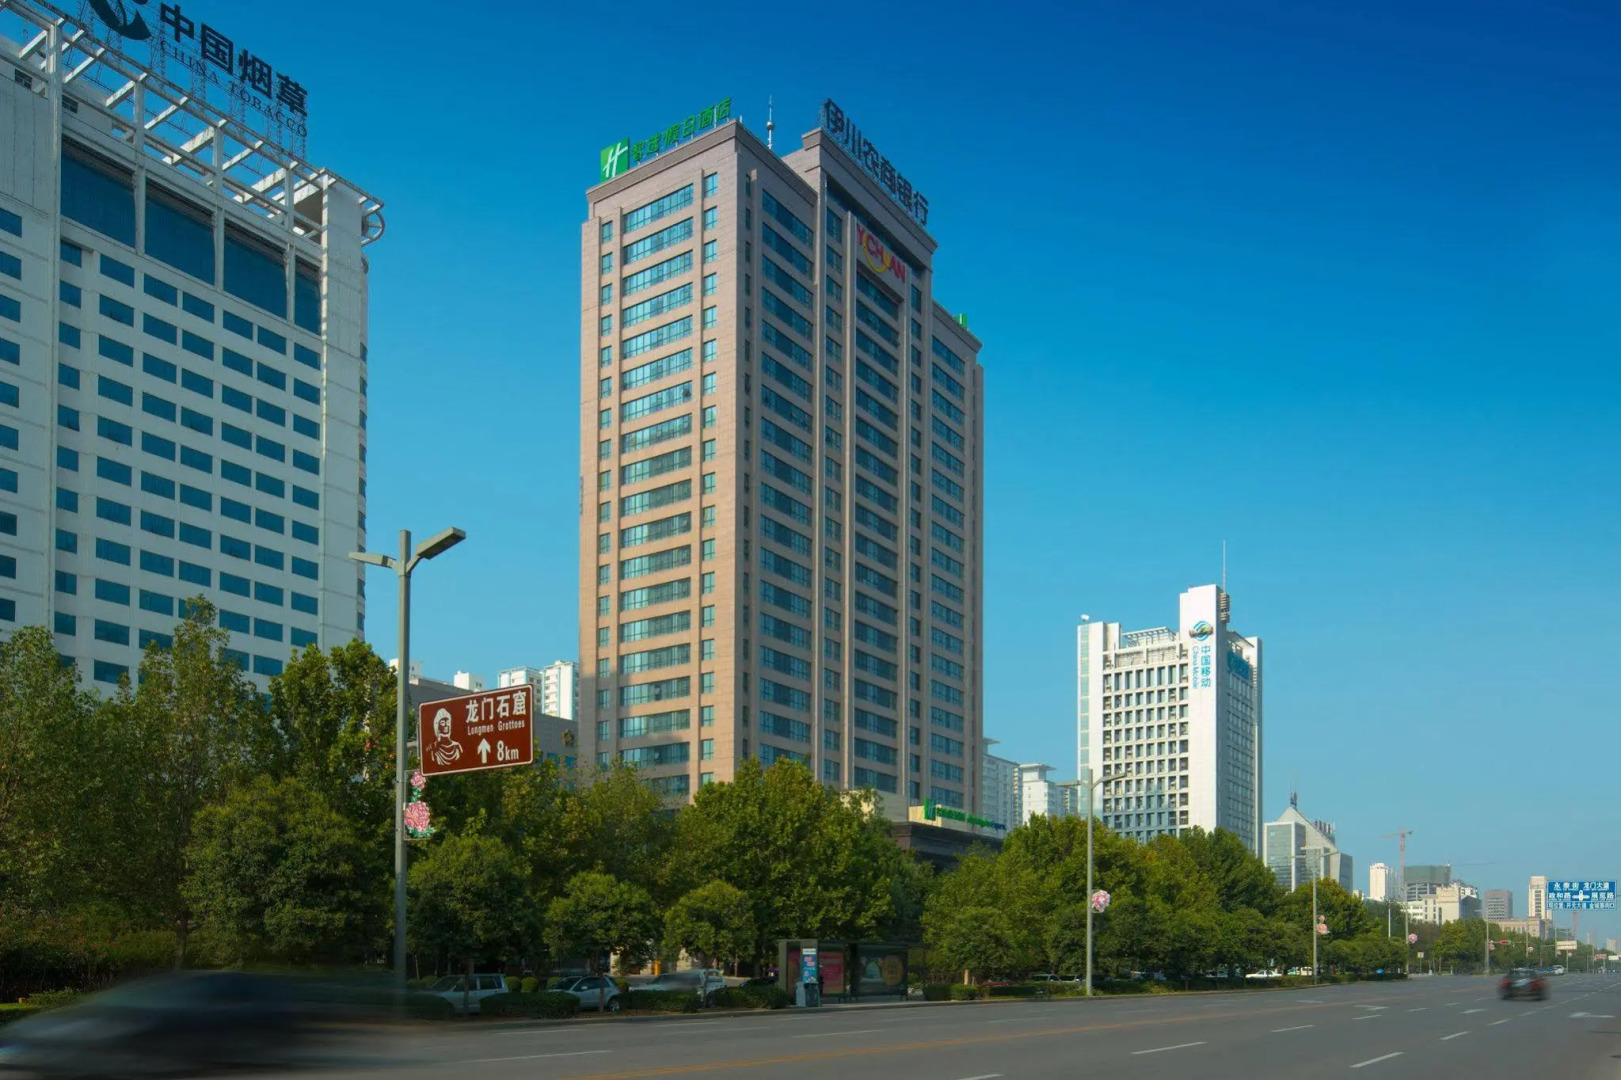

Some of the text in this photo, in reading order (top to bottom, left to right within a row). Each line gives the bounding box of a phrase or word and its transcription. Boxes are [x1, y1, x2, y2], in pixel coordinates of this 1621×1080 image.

[160, 3, 307, 117] 中国烟草
[160, 40, 307, 138] CHINA TOBACCO
[824, 98, 929, 227] 伊川农商银行
[1201, 645, 1210, 687] 中国移动
[465, 691, 526, 723] 龙门石窟
[467, 719, 525, 736] Longmen Grottoes
[497, 740, 519, 761] 8km
[1583, 882, 1609, 891] 龙门大道
